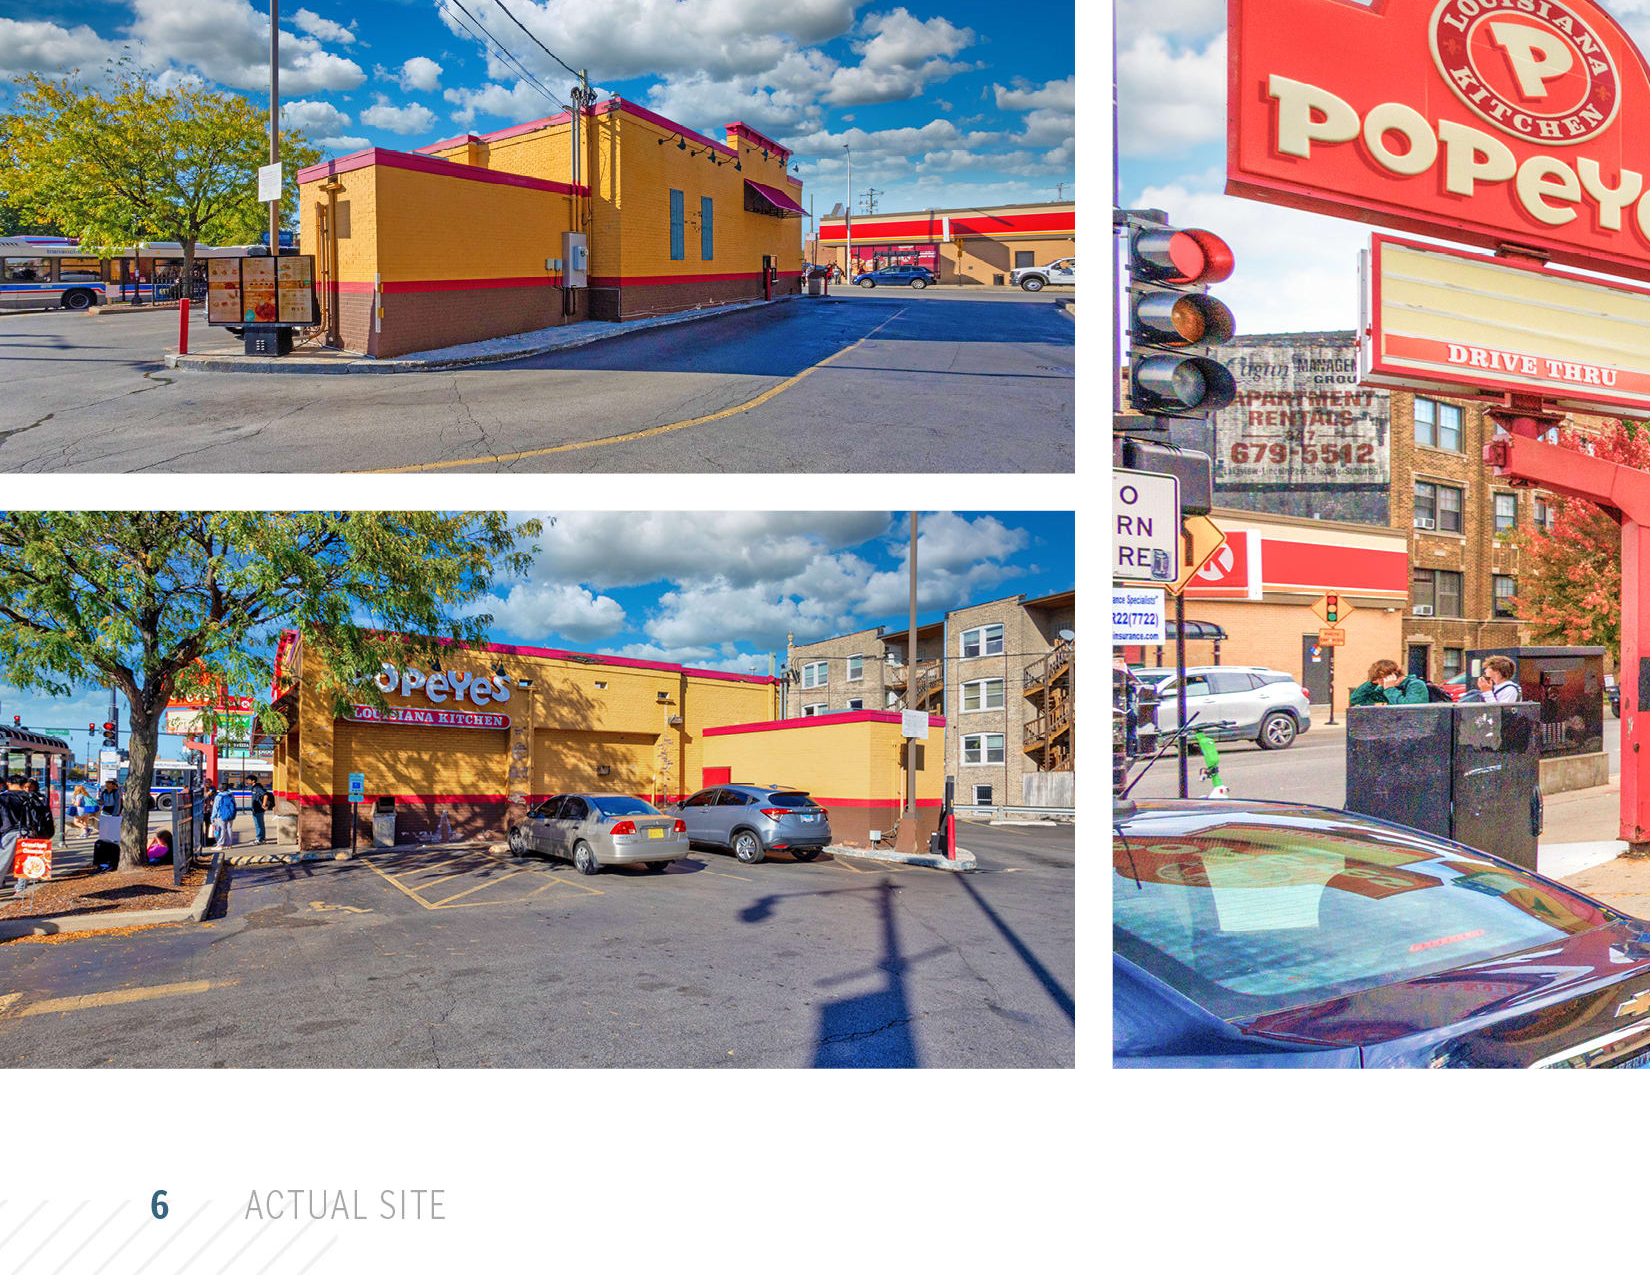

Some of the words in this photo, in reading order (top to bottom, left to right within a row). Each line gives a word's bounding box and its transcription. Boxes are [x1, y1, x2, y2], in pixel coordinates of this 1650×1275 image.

[1489, 22, 1573, 98] P
[1449, 65, 1605, 140] KITCHEN
[1447, 343, 1538, 378] DRIVE
[1547, 360, 1617, 387] THRU
[1231, 391, 1376, 407] APARTMENT
[1248, 410, 1353, 426] RENTALS
[1230, 443, 1375, 464] 679-5512
[439, 713, 503, 726] KITCHEN
